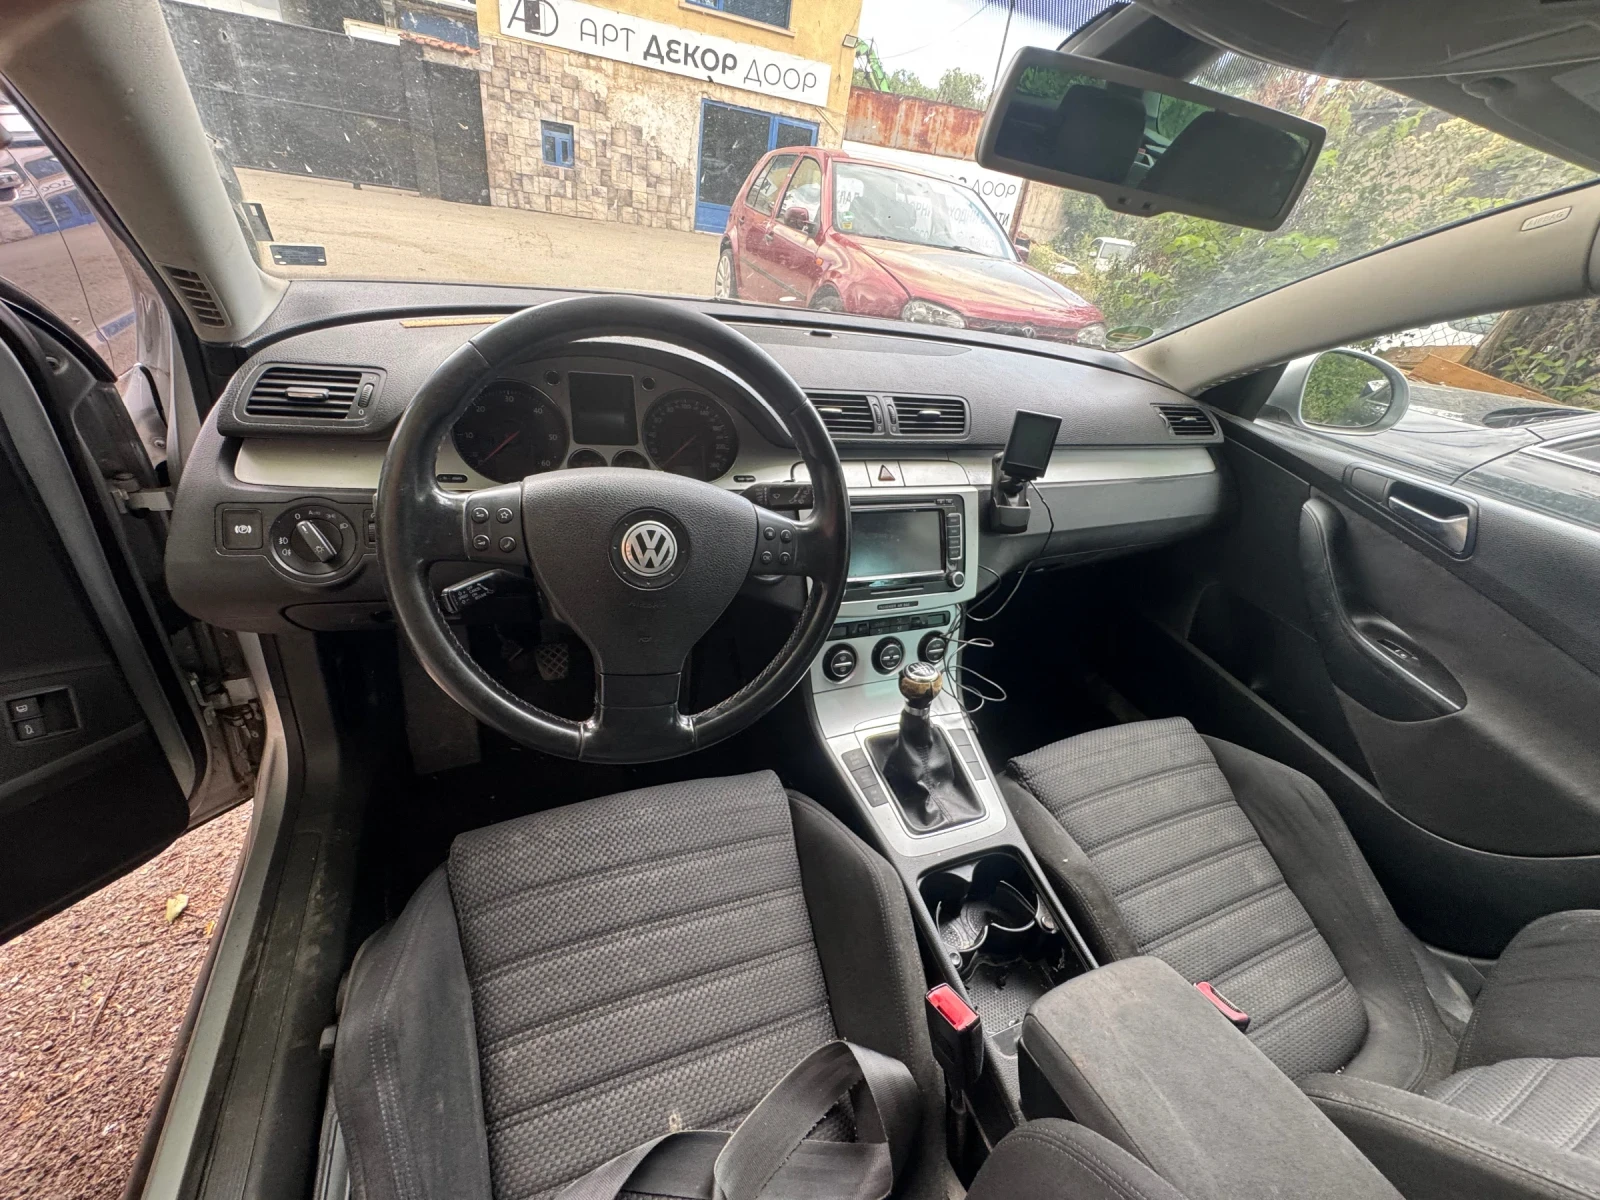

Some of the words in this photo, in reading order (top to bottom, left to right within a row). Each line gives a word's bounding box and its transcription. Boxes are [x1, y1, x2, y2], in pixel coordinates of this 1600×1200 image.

[580, 18, 635, 52] АРТ
[643, 35, 738, 74] ДЕКОР
[743, 59, 817, 92] ДООР
